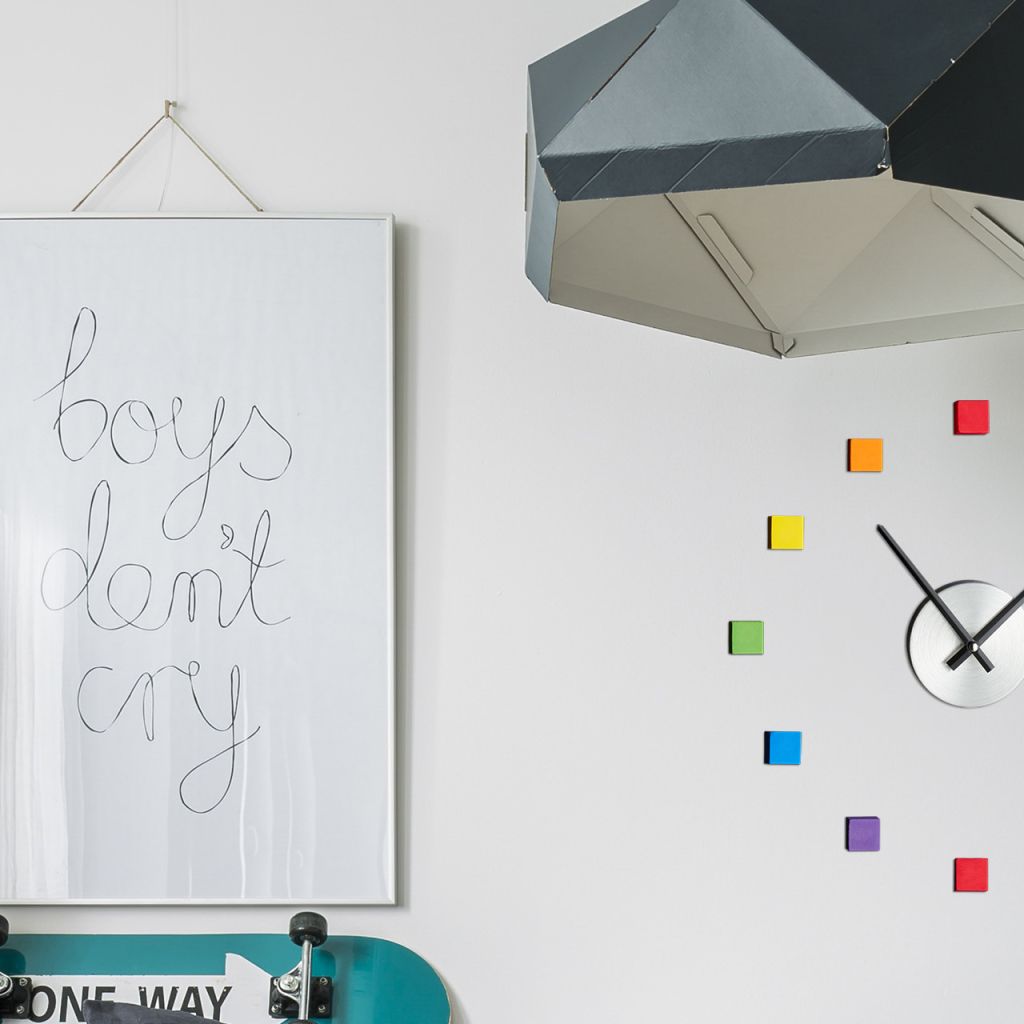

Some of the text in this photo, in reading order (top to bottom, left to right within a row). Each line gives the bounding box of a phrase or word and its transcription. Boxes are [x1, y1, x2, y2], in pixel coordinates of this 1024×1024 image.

[34, 307, 293, 540] boys
[41, 480, 291, 631] don't
[77, 661, 260, 814] cry
